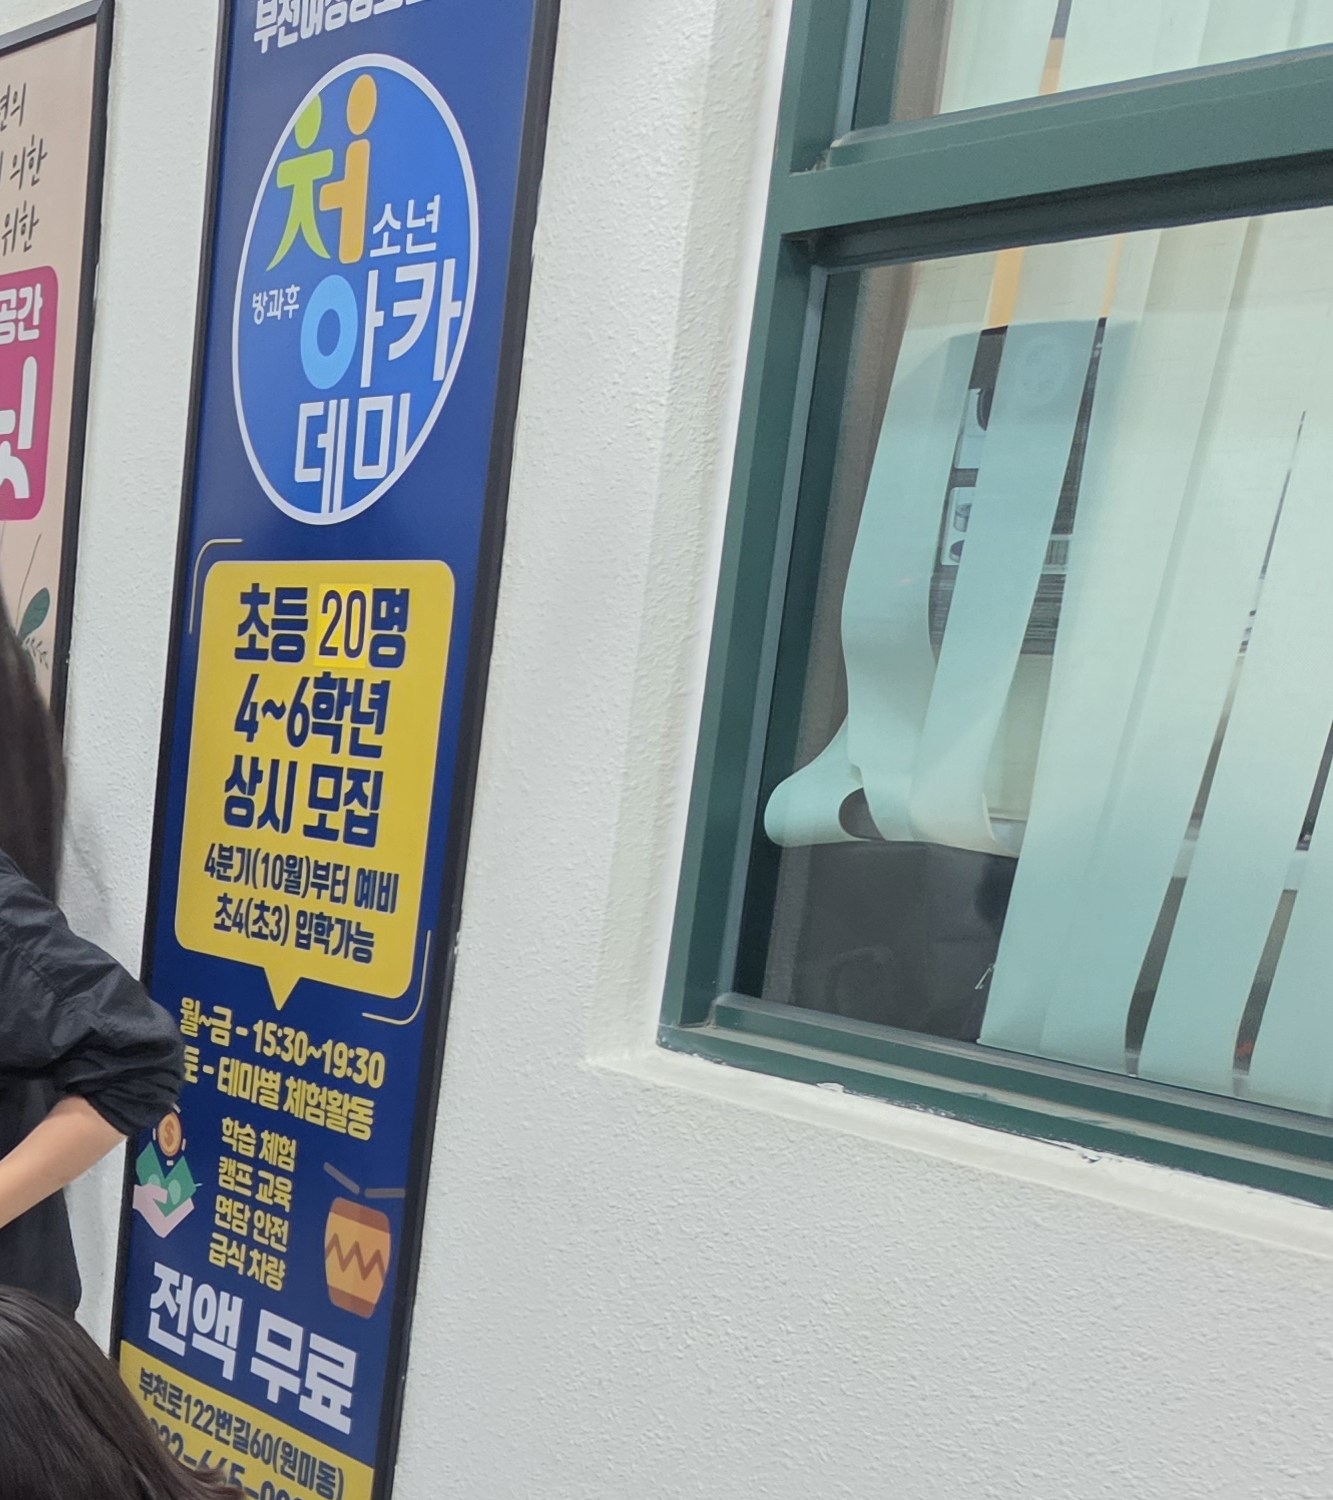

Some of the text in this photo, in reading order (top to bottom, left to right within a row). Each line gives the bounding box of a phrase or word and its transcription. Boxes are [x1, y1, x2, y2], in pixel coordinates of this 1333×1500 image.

[9, 134, 48, 191] 의한
[1, 200, 40, 257] 위한
[251, 284, 301, 325] 방과후
[234, 583, 410, 668] 초등 20명
[233, 671, 391, 758] 4~6학년
[223, 754, 384, 848] 상시 모집
[203, 843, 399, 914] 4분기(10월)부터 예비
[213, 892, 375, 964] 초4(초3) 입학가능
[180, 997, 232, 1047] 월~금
[253, 1019, 386, 1089] 15:30~19:30
[217, 1056, 282, 1110] 테마별
[283, 1075, 375, 1141] 체험활동
[221, 1116, 298, 1172] 학습 체험
[218, 1156, 293, 1213] 캠프 교육
[214, 1195, 289, 1253] 면담 안전
[208, 1232, 286, 1292] 급식 차량
[148, 1261, 357, 1435] 전액 무료
